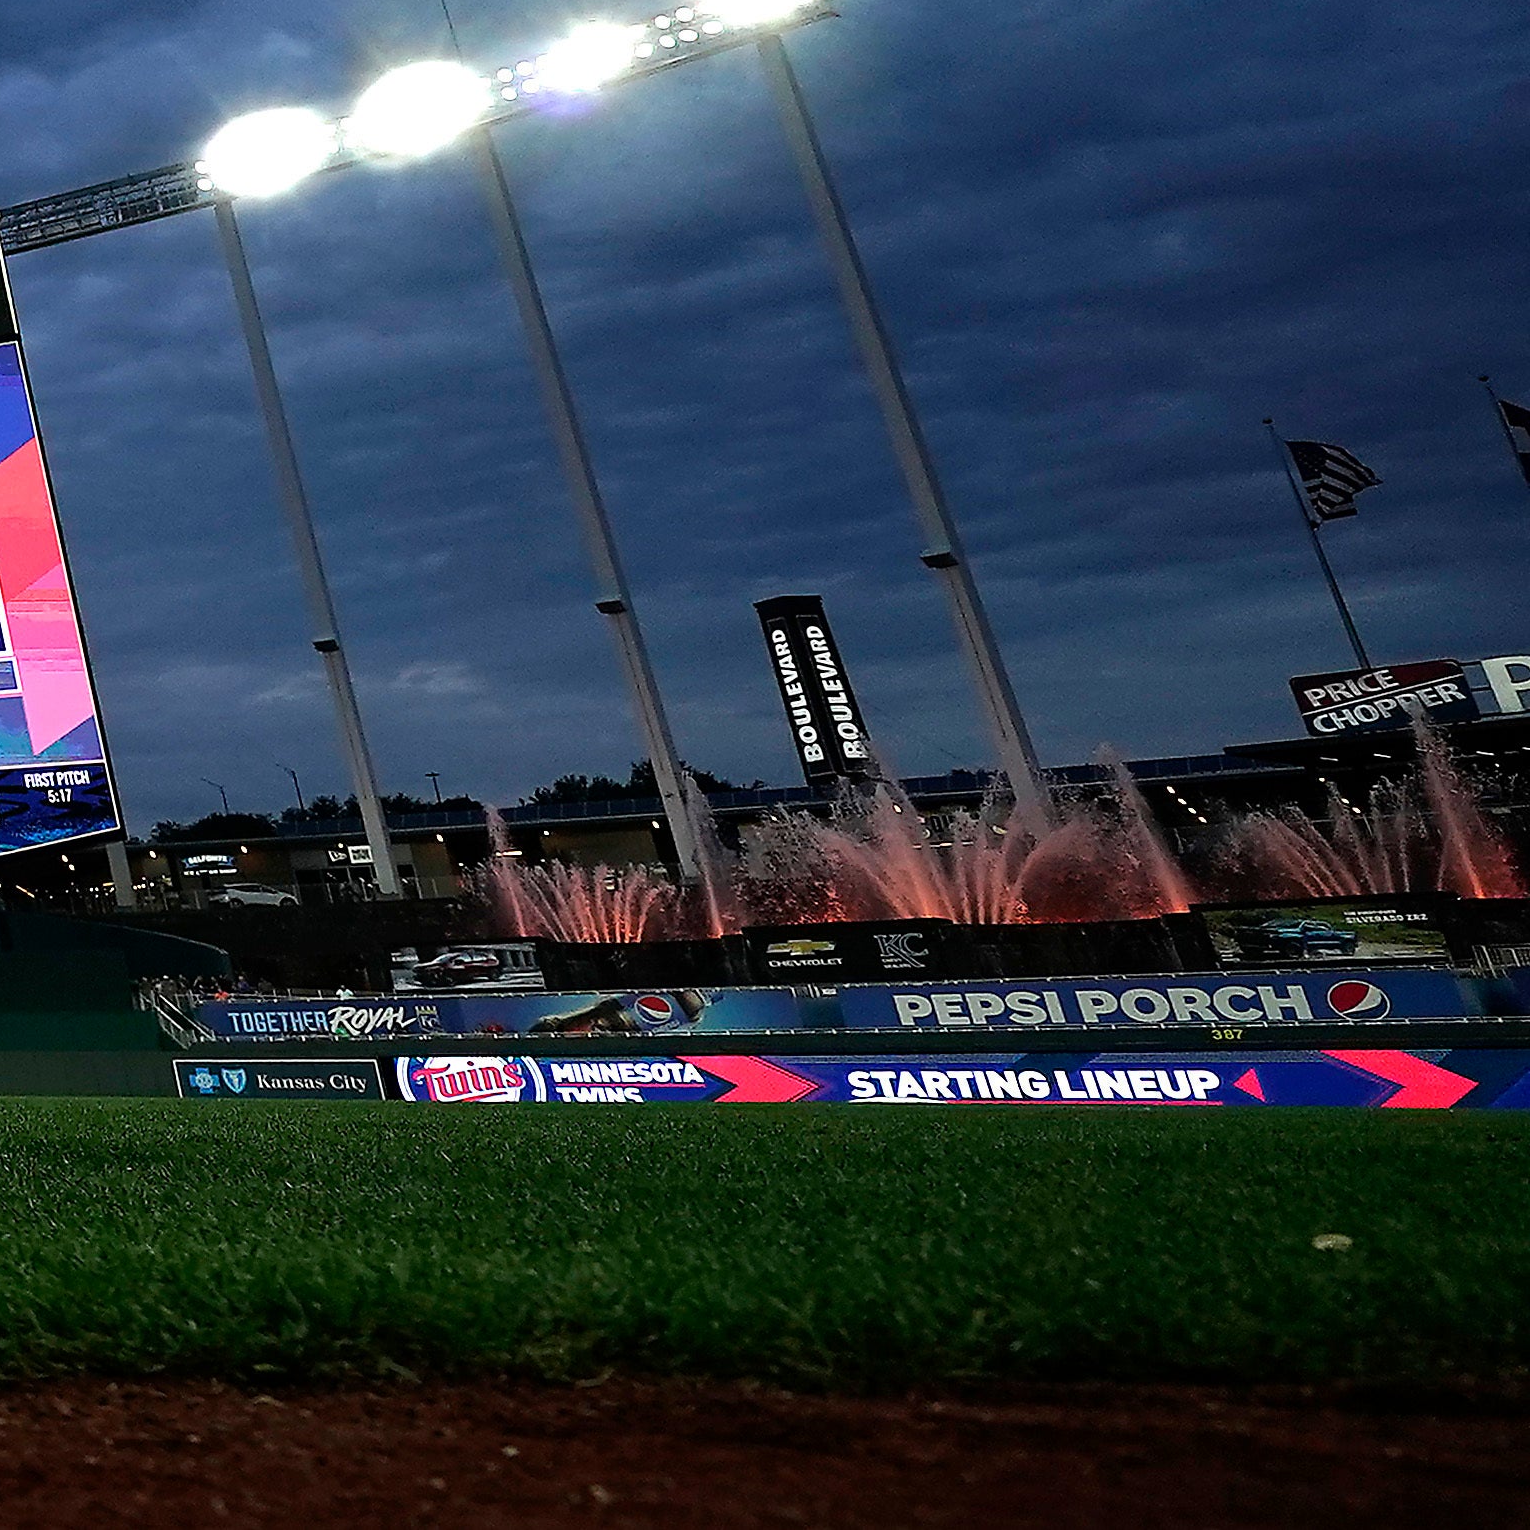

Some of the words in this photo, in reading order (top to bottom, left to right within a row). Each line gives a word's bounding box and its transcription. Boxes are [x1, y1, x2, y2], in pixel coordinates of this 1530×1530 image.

[772, 629, 825, 762] BOULEVARD
[806, 625, 869, 759] BOULEVARD
[1303, 670, 1399, 708] PRICE
[1313, 682, 1467, 732] CHOPPER
[23, 771, 55, 789] FIRST
[55, 770, 91, 786] PITCH
[47, 788, 72, 804] 5:17
[768, 957, 844, 968] CHEVROLET
[892, 989, 1066, 1026] PEPSI
[1074, 985, 1315, 1025] PORCH
[227, 1011, 328, 1034] TOGETHER
[326, 1006, 418, 1036] ROYAL
[1210, 1028, 1244, 1040] 387
[255, 1074, 325, 1091] Kansas
[328, 1074, 368, 1094] City
[411, 1060, 526, 1102] Twins
[550, 1062, 705, 1084] MINNESOTA
[847, 1070, 1050, 1100] STARTING
[1054, 1068, 1221, 1100] LINEUP
[554, 1086, 644, 1103] TWINS
